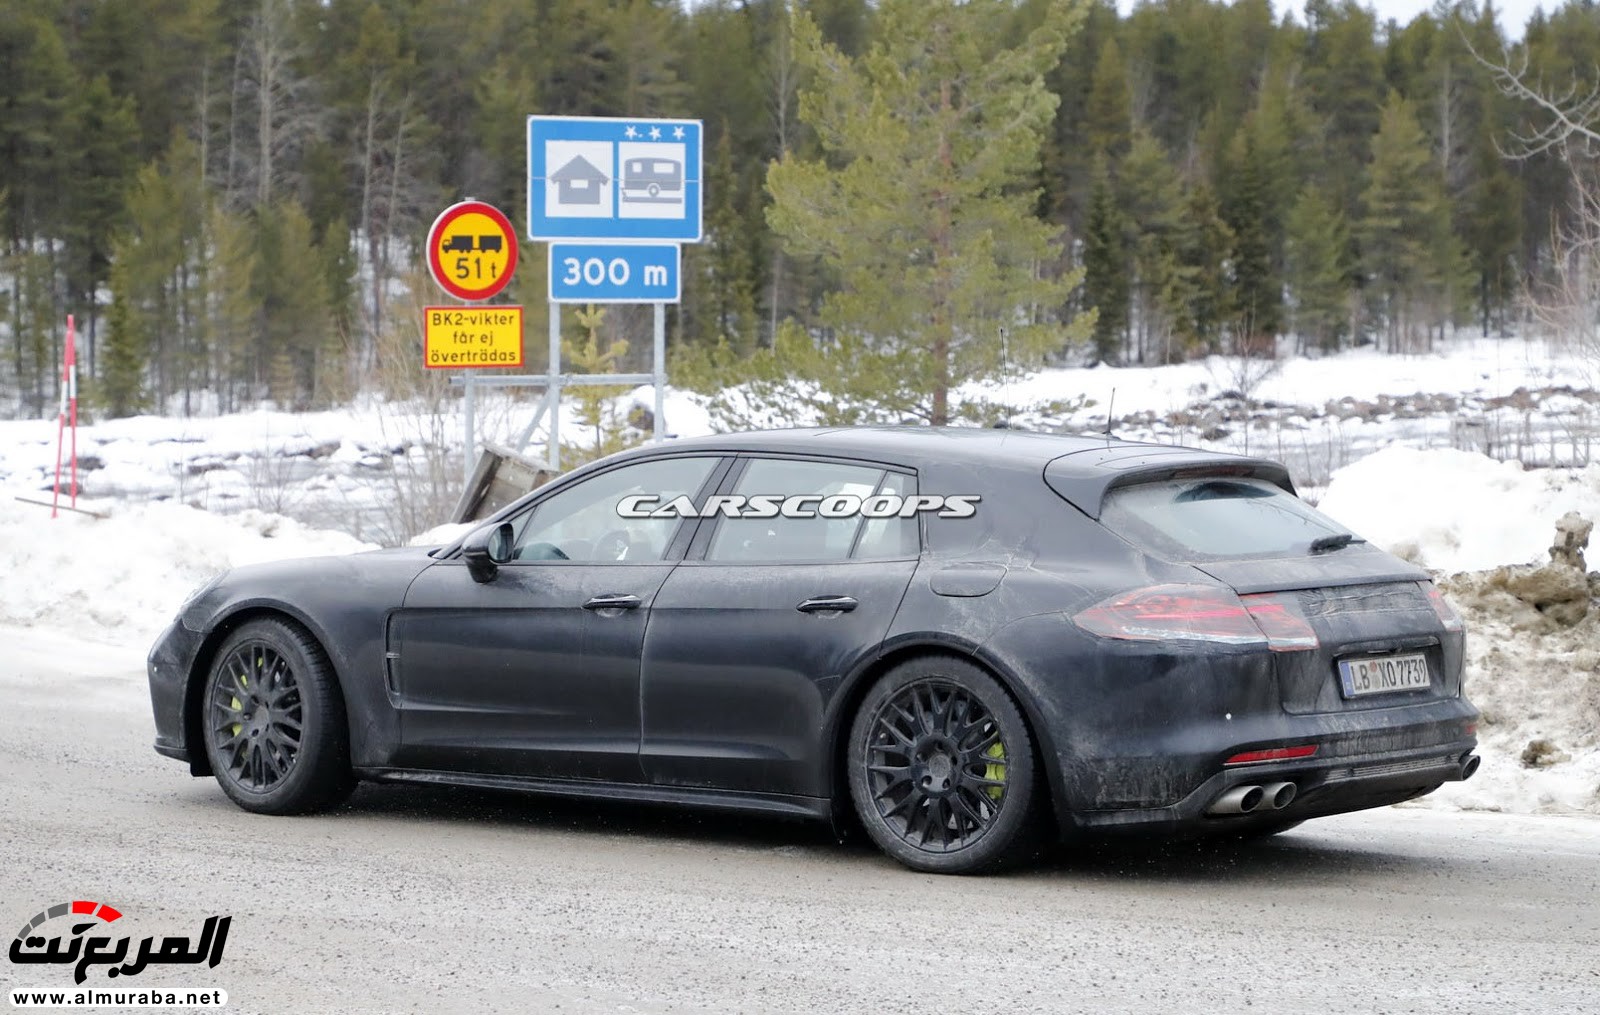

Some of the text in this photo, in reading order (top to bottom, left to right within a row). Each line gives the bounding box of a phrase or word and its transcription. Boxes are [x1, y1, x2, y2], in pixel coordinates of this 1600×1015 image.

[456, 258, 497, 279] 51 t
[563, 258, 667, 286] 300 m
[432, 313, 514, 326] BK2-vikter
[453, 331, 493, 345] får ej
[431, 349, 516, 363] överträdas
[1351, 664, 1370, 690] LB
